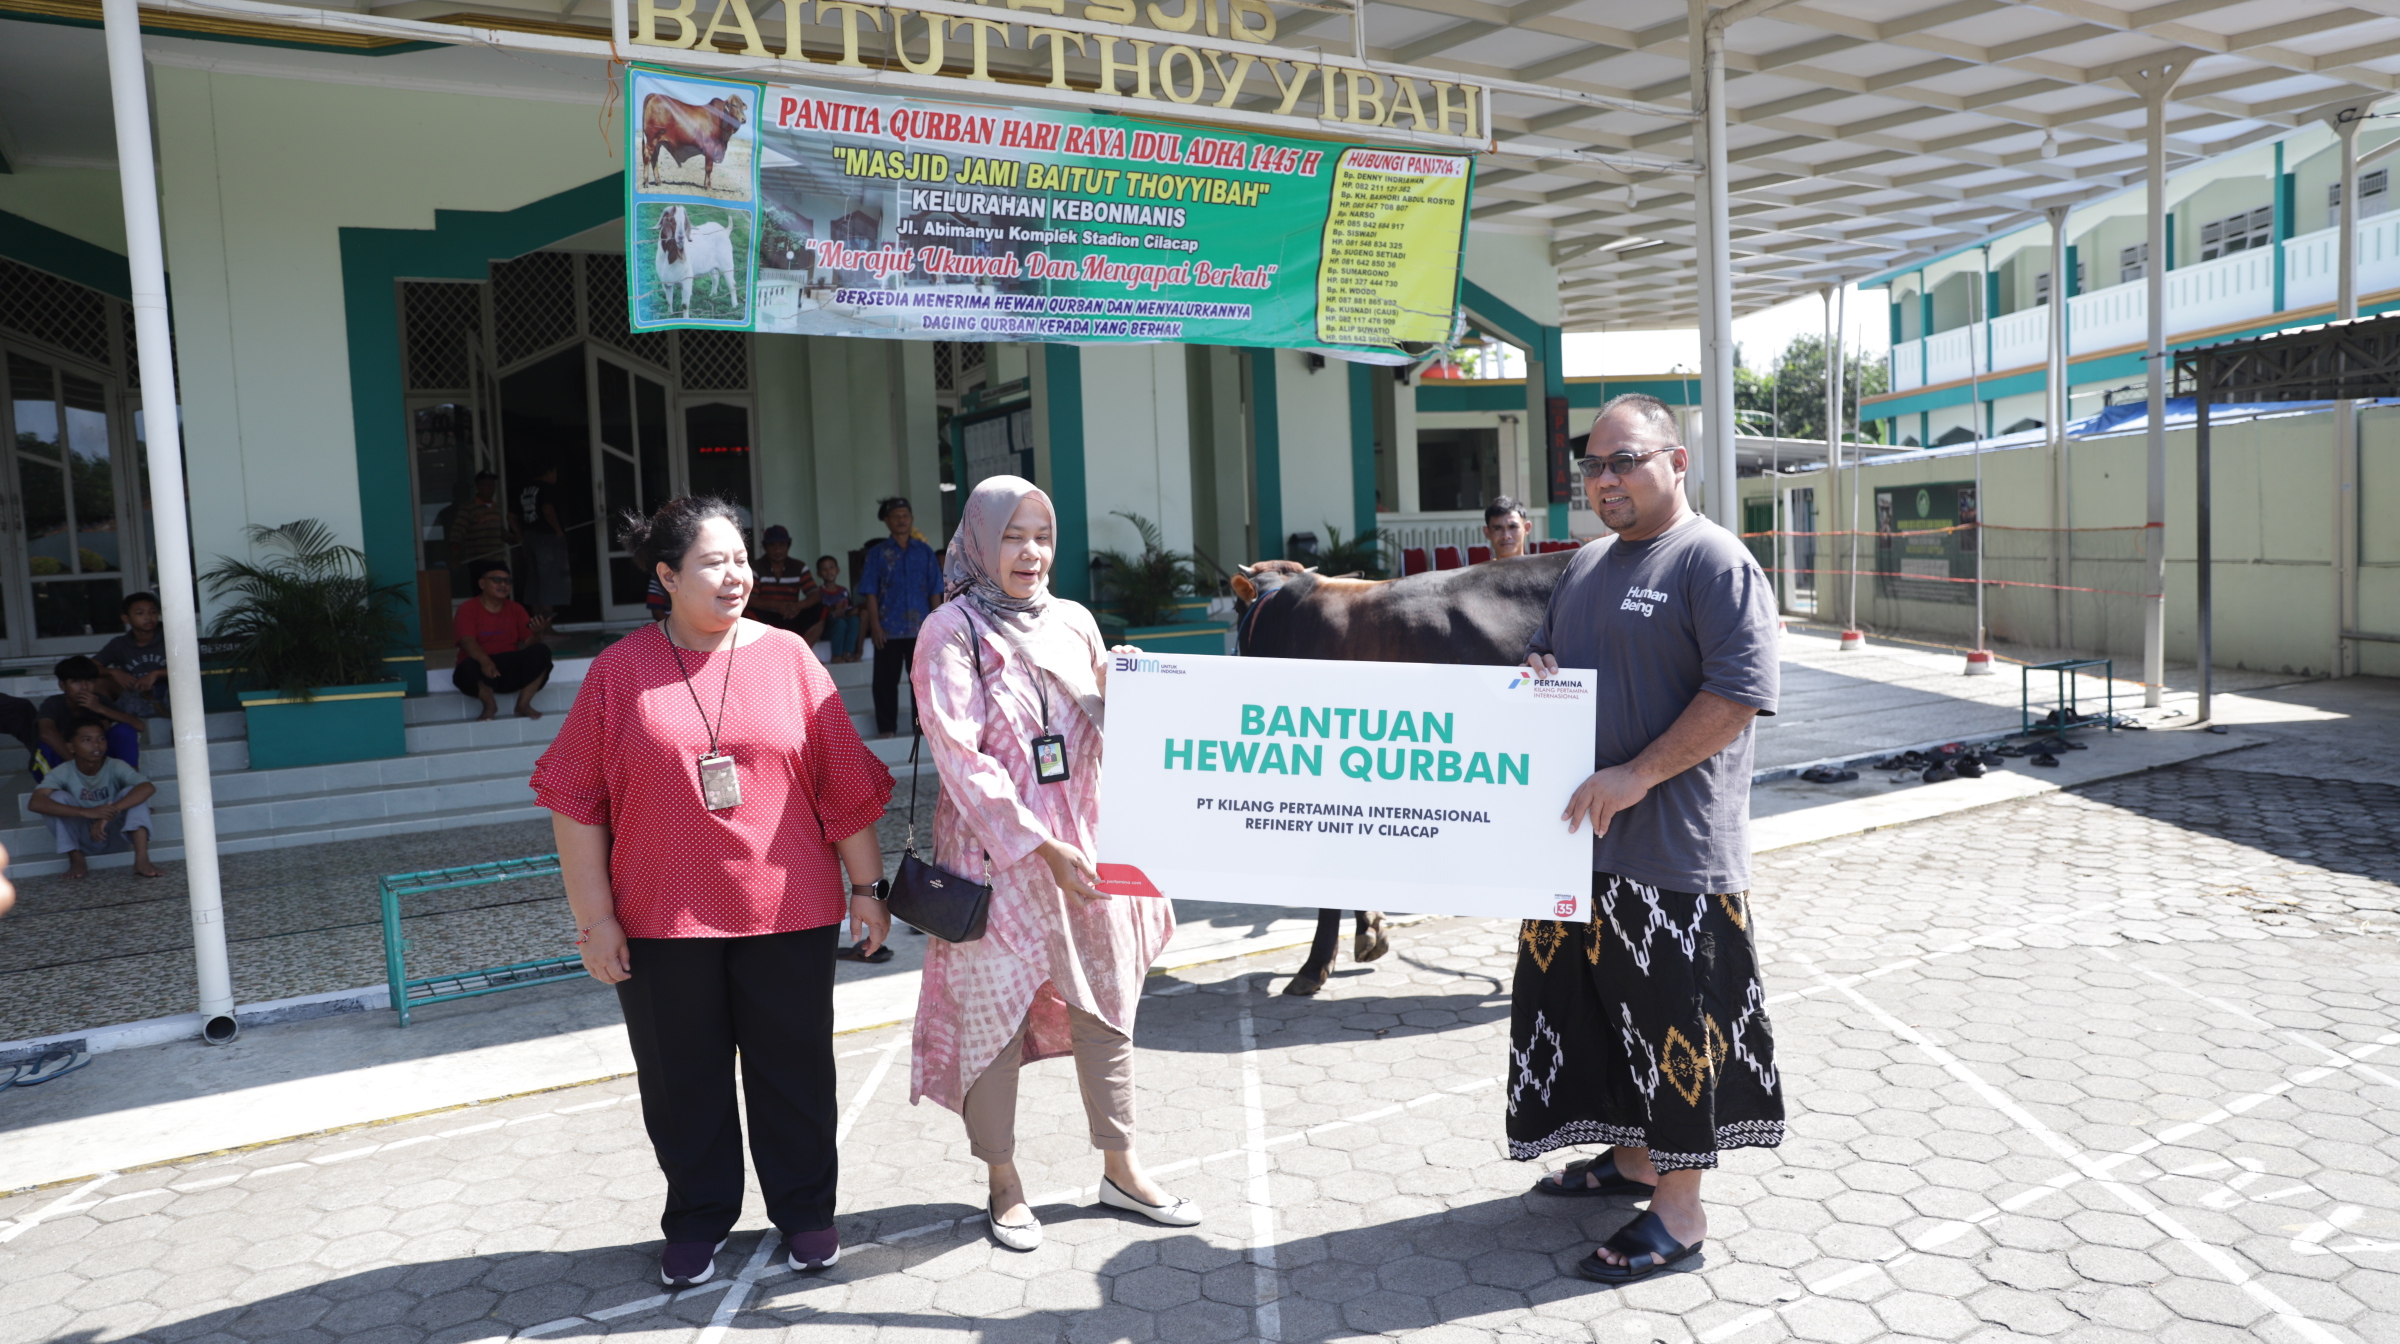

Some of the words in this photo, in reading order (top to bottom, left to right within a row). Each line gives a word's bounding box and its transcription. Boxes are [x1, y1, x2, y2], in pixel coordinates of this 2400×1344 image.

[630, 0, 1009, 83] BAITUT
[1028, 26, 1482, 140] THOYYIBAH
[778, 97, 880, 135] PANITIA
[889, 108, 996, 146] QURBAN
[999, 117, 1061, 153] HARI
[1063, 125, 1125, 160] RAYA
[1130, 131, 1184, 166] IDUL
[1185, 137, 1245, 170] ADHA
[1251, 143, 1300, 174] 1445
[1299, 150, 1322, 176] H
[1347, 152, 1405, 171] HUBUNGI
[1407, 157, 1453, 174] PANITIA
[833, 146, 948, 181] "MASJID
[955, 158, 1018, 189] JAMI
[1026, 162, 1120, 196] BAITUT
[1125, 168, 1271, 207] THOYYIBAH"
[1357, 173, 1382, 181] DENNY
[912, 189, 1045, 219] KELURAHAN
[1051, 196, 1186, 228] KEBONMANIS
[1380, 203, 1394, 211] 708
[1427, 197, 1455, 206] ROSYID
[1349, 211, 1375, 219] NARSO
[1347, 220, 1360, 228] 085
[1363, 221, 1377, 229] 842
[897, 221, 918, 236] Jl.
[923, 220, 1003, 242] Abimanyu
[1009, 226, 1078, 246] Komplek
[1082, 230, 1139, 248] Stadion
[1144, 233, 1198, 253] Cilacap
[1333, 228, 1344, 236] Bp.
[1347, 230, 1377, 238] SISWADI
[1346, 239, 1358, 247] 081
[1332, 248, 1342, 256] Bp.
[1344, 249, 1374, 258] SUGENG
[1376, 250, 1406, 259] SETIADI
[806, 240, 914, 280] "Merajut
[918, 248, 1020, 278] Ukuwah
[1026, 252, 1077, 280] Dan
[1081, 256, 1190, 291] Mengapai
[1194, 261, 1277, 290] Berkah"
[1341, 258, 1354, 266] 081
[1356, 259, 1370, 267] 642
[1372, 260, 1385, 268] 850
[1328, 267, 1338, 275] Bp.
[1341, 268, 1389, 277] SUMARGONO
[1370, 279, 1383, 287] 444
[1385, 280, 1398, 288] 730
[835, 289, 909, 308] BERSEDIA
[913, 293, 991, 311] MENERIMA
[994, 296, 1045, 312] HEWAN
[1048, 298, 1105, 314] QURBAN
[1107, 300, 1131, 315] DAN
[1135, 301, 1251, 320] MENYALURKANNYA
[1326, 306, 1337, 314] Bp.
[1339, 306, 1372, 315] KUSNADI
[922, 315, 976, 333] DAGING
[980, 317, 1035, 335] QURBAN
[1038, 318, 1086, 336] KEPADA
[1088, 320, 1126, 336] YANG
[1129, 321, 1181, 337] BERHAK
[1326, 325, 1337, 333] Bp.
[1339, 325, 1355, 333] ALIP
[1554, 416, 1566, 484] PRIA
[1626, 586, 1668, 603] Human
[1620, 598, 1654, 617] Being
[1116, 657, 1160, 673] BUMN
[1534, 679, 1582, 687] PERTAMINA
[1241, 704, 1454, 744] BANTUAN
[1163, 739, 1323, 777] HEWAN
[1339, 746, 1530, 786] QURBAN
[1196, 799, 1213, 810] PT
[1218, 799, 1275, 814] KILANG
[1279, 802, 1364, 818] PERTAMINA
[1368, 806, 1491, 824] INTERNASIONAL
[1245, 818, 1314, 833] REFINERY
[1318, 821, 1354, 834] UNIT
[1358, 823, 1374, 834] IV
[1378, 824, 1439, 839] CILACAP
[1554, 903, 1573, 915] 135
